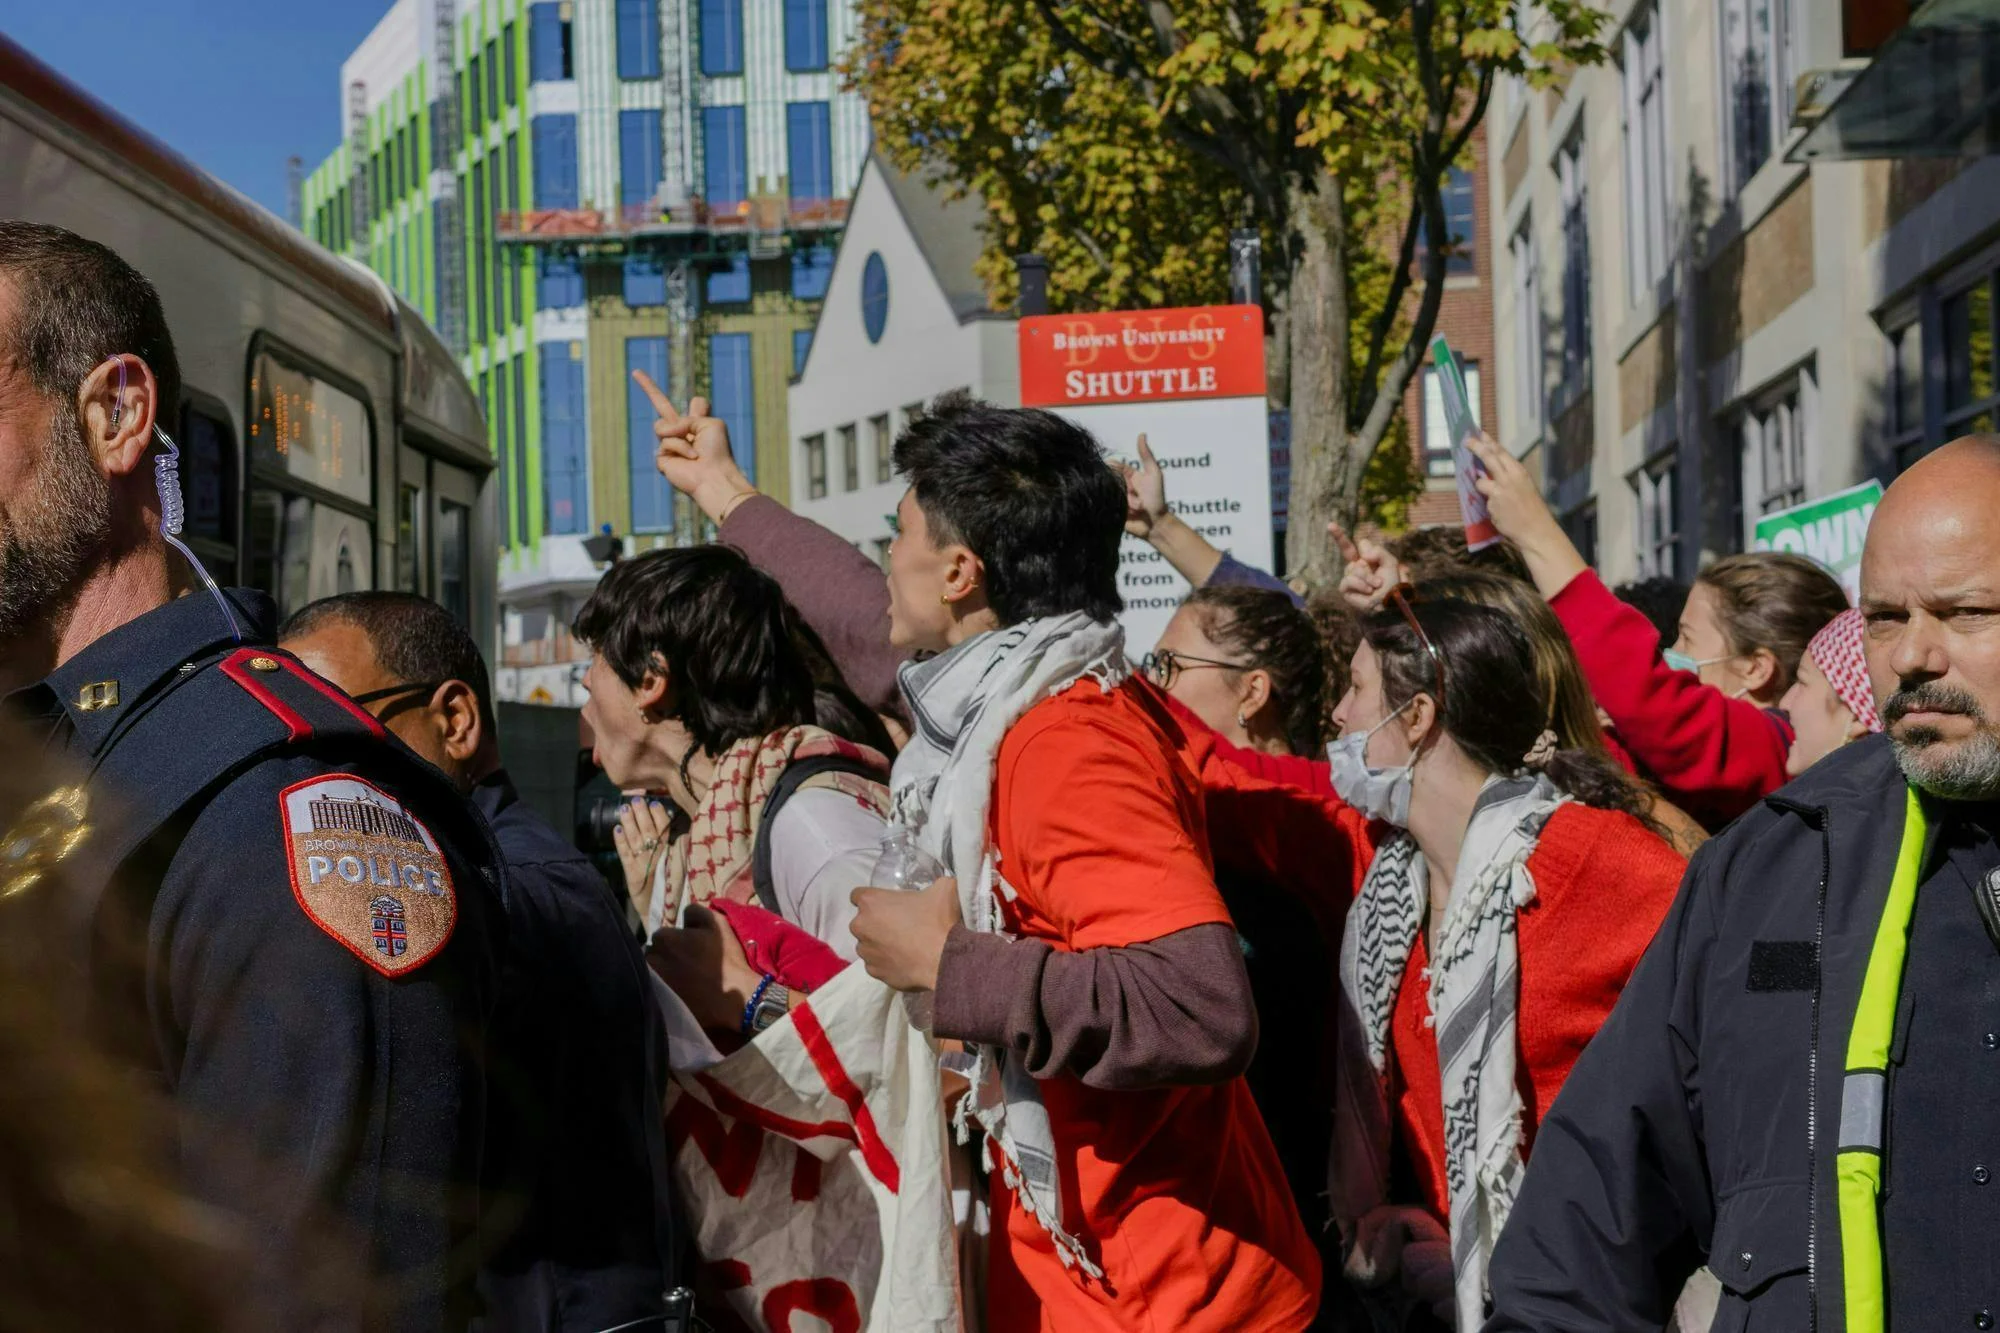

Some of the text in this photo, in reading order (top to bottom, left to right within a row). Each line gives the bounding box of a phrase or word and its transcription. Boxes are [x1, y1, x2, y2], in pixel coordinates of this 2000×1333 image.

[1053, 327, 1226, 350] BROWN UNIVERSITY
[1062, 313, 1216, 366] BUS
[1066, 367, 1218, 398] SHUTTLE
[1167, 498, 1241, 514] Shuttle
[1124, 571, 1174, 587] from
[307, 855, 445, 897] POLICE
